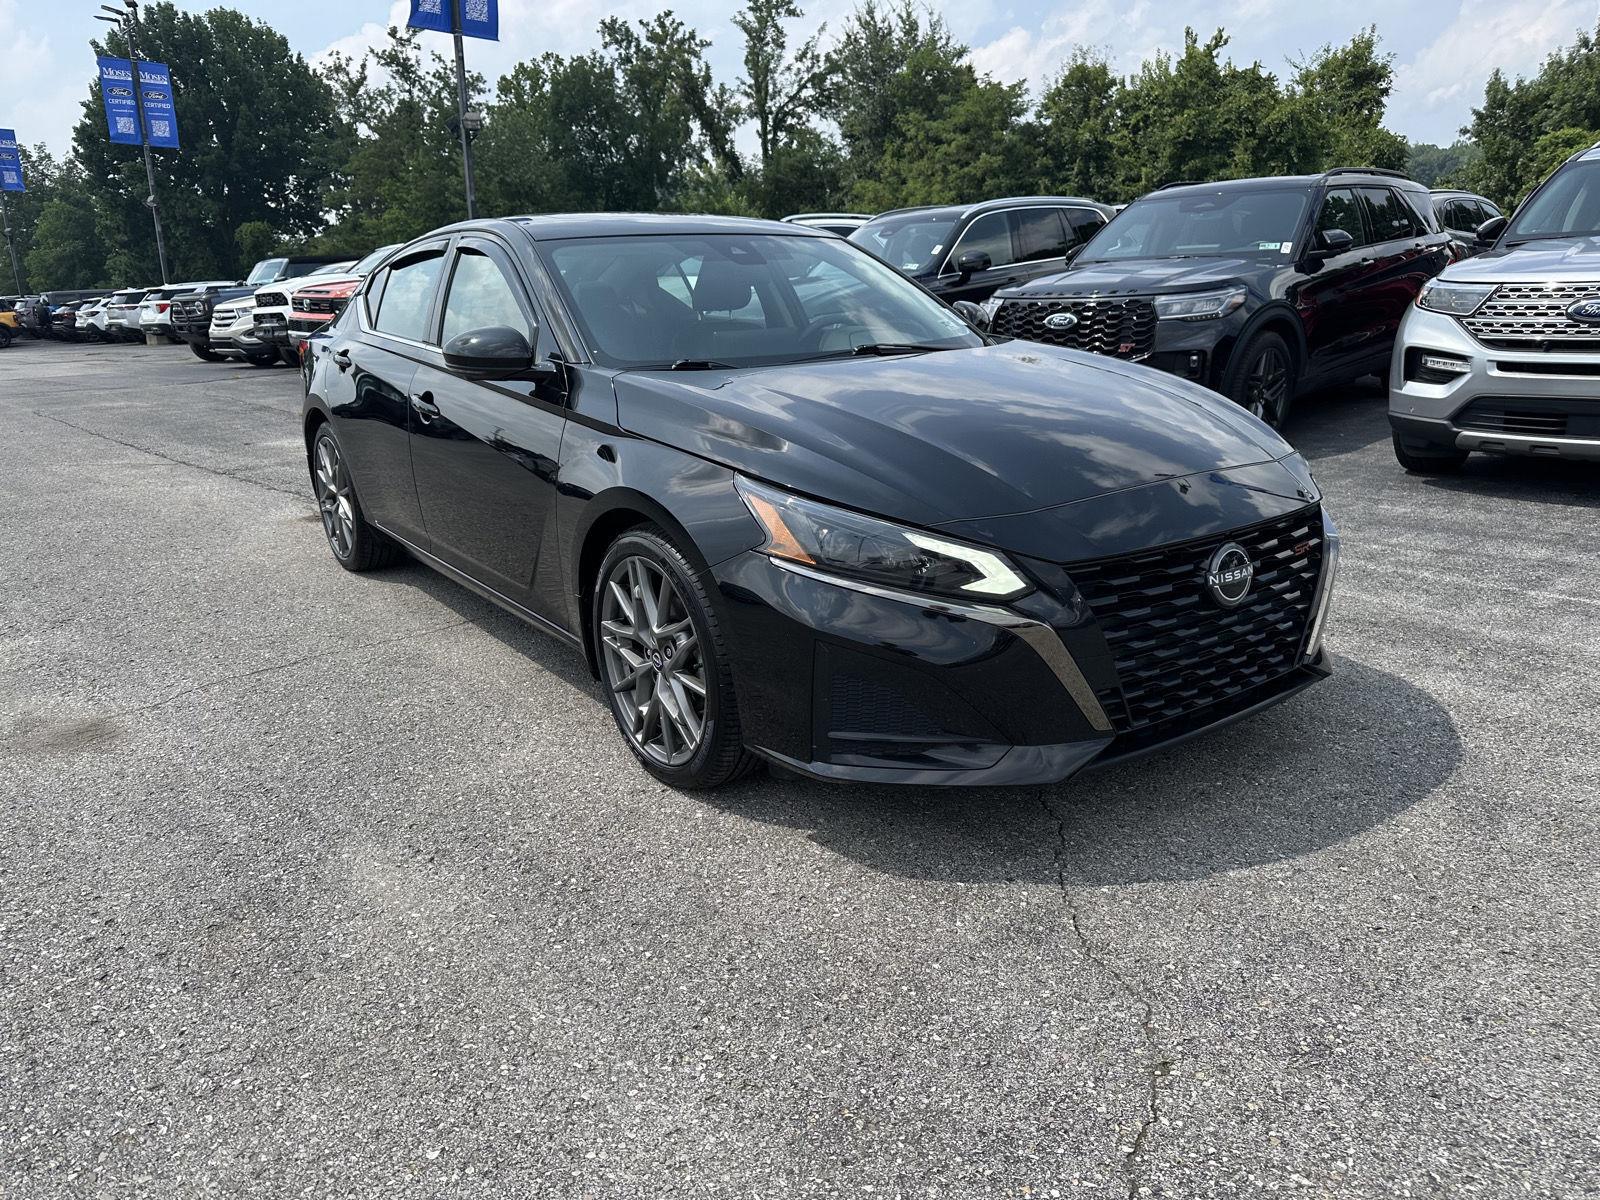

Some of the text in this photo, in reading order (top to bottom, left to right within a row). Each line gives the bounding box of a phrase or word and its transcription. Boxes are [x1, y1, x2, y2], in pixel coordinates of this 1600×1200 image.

[102, 67, 132, 77] MOSES
[139, 71, 168, 81] MOSES
[1051, 316, 1070, 325] Ford
[1294, 542, 1312, 555] SR
[1209, 564, 1253, 585] NISSAN
